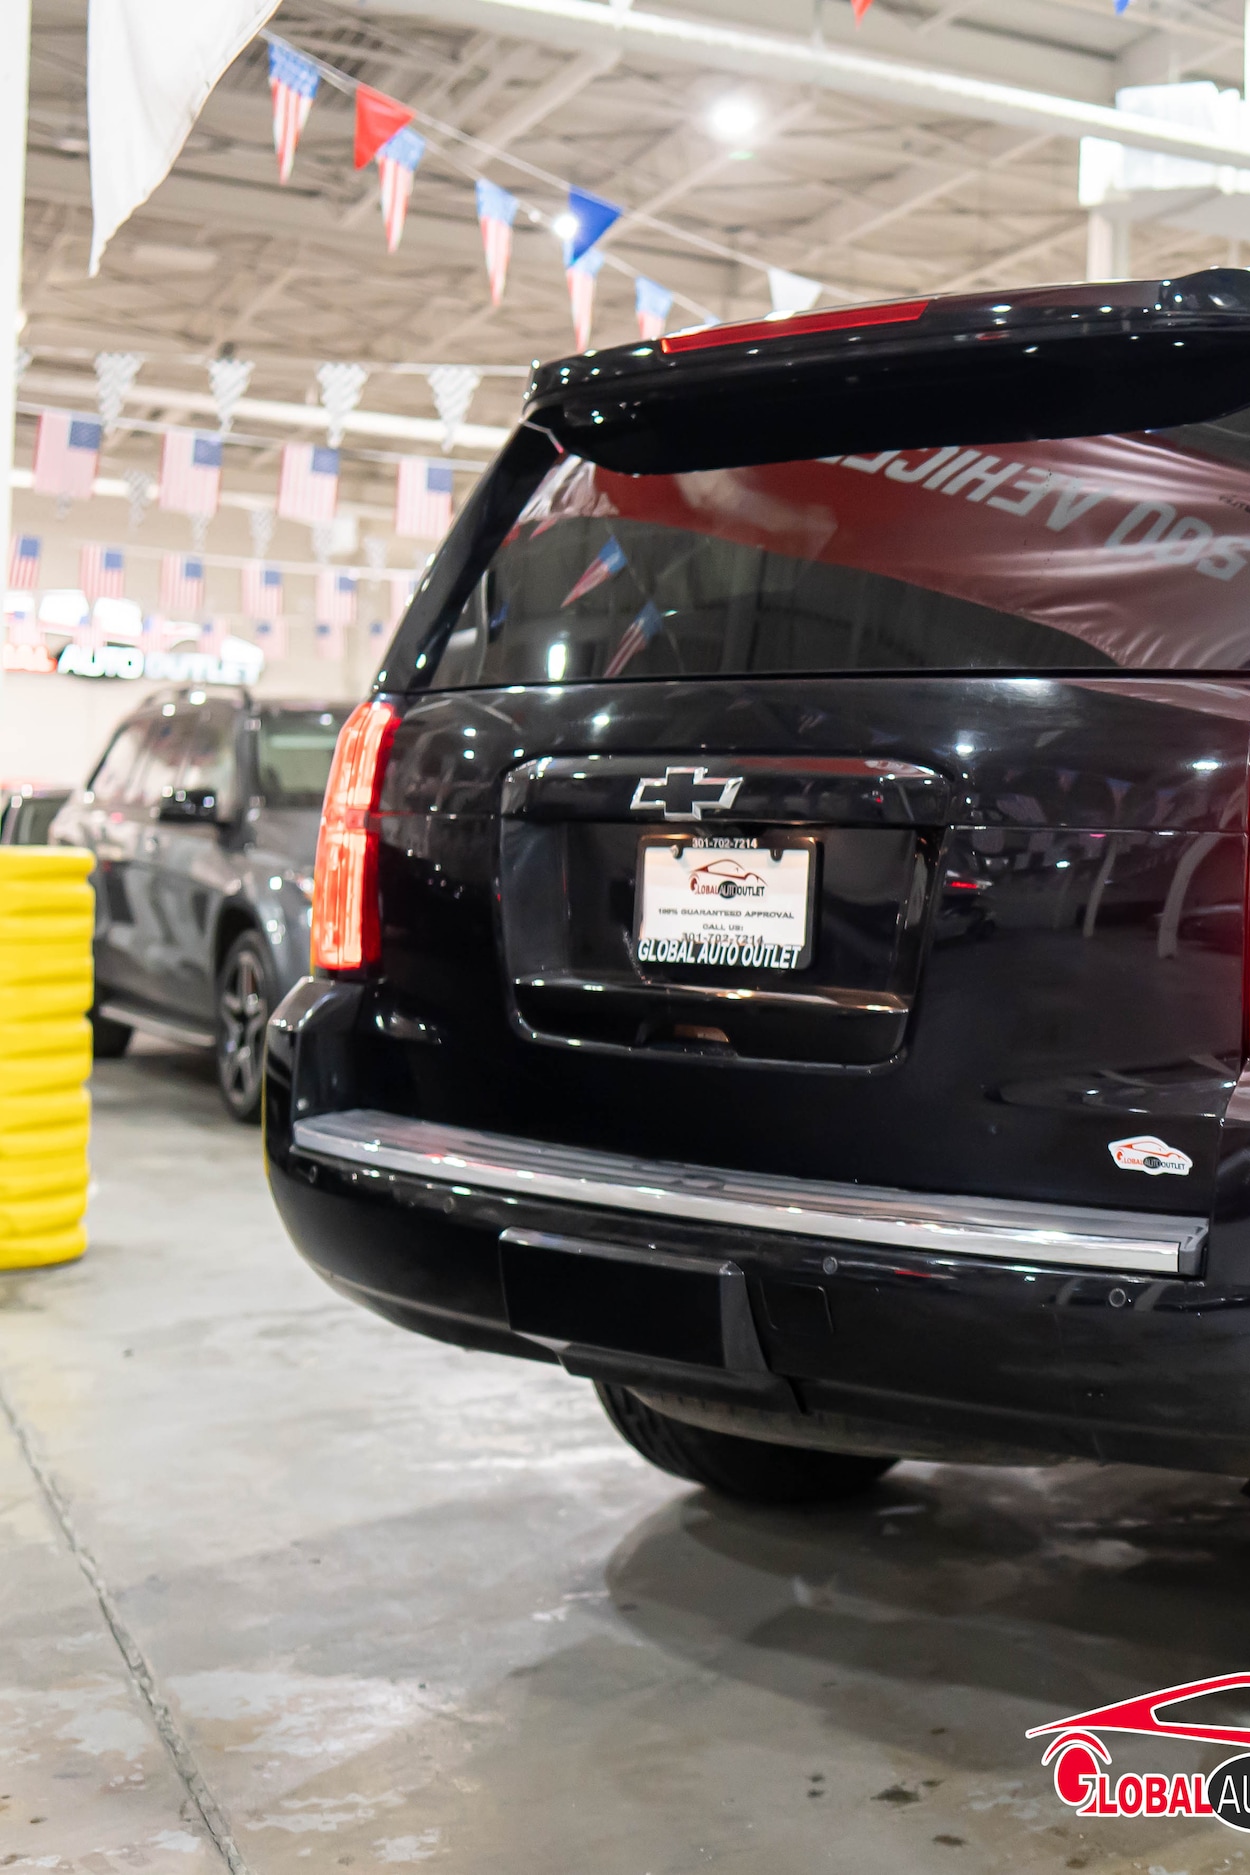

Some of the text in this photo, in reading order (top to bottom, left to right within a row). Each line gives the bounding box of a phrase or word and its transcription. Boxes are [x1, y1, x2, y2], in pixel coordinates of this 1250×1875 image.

[692, 837, 758, 849] 301-702-7214
[681, 909, 742, 918] GUARANTEED
[744, 911, 795, 920] APPROVAL
[702, 923, 726, 931] CALL
[638, 939, 802, 969] GLOBAL AUTO OUTLET
